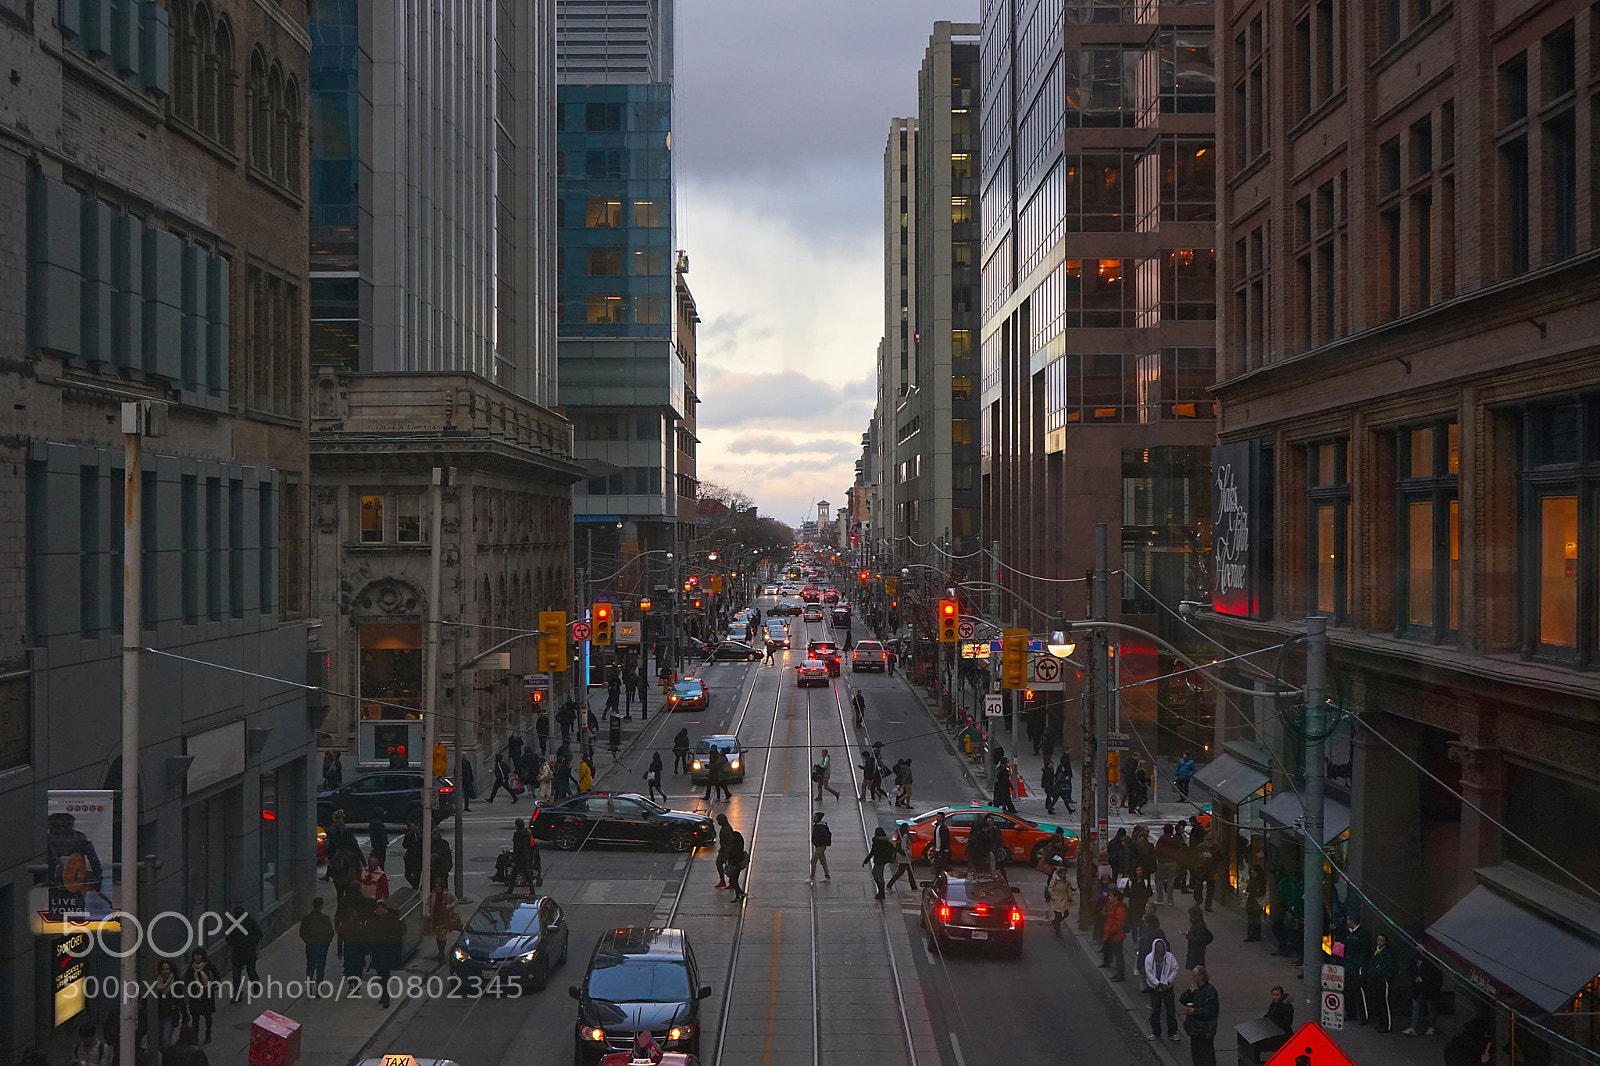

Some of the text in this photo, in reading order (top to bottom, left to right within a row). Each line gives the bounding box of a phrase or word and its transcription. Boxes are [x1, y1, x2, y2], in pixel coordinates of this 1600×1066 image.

[1215, 464, 1238, 525] Saks
[1227, 505, 1248, 560] Fifth
[1215, 537, 1246, 595] Avenue
[987, 703, 1001, 714] 40
[51, 898, 77, 906] LIVE
[385, 1057, 410, 1066] TAXI
